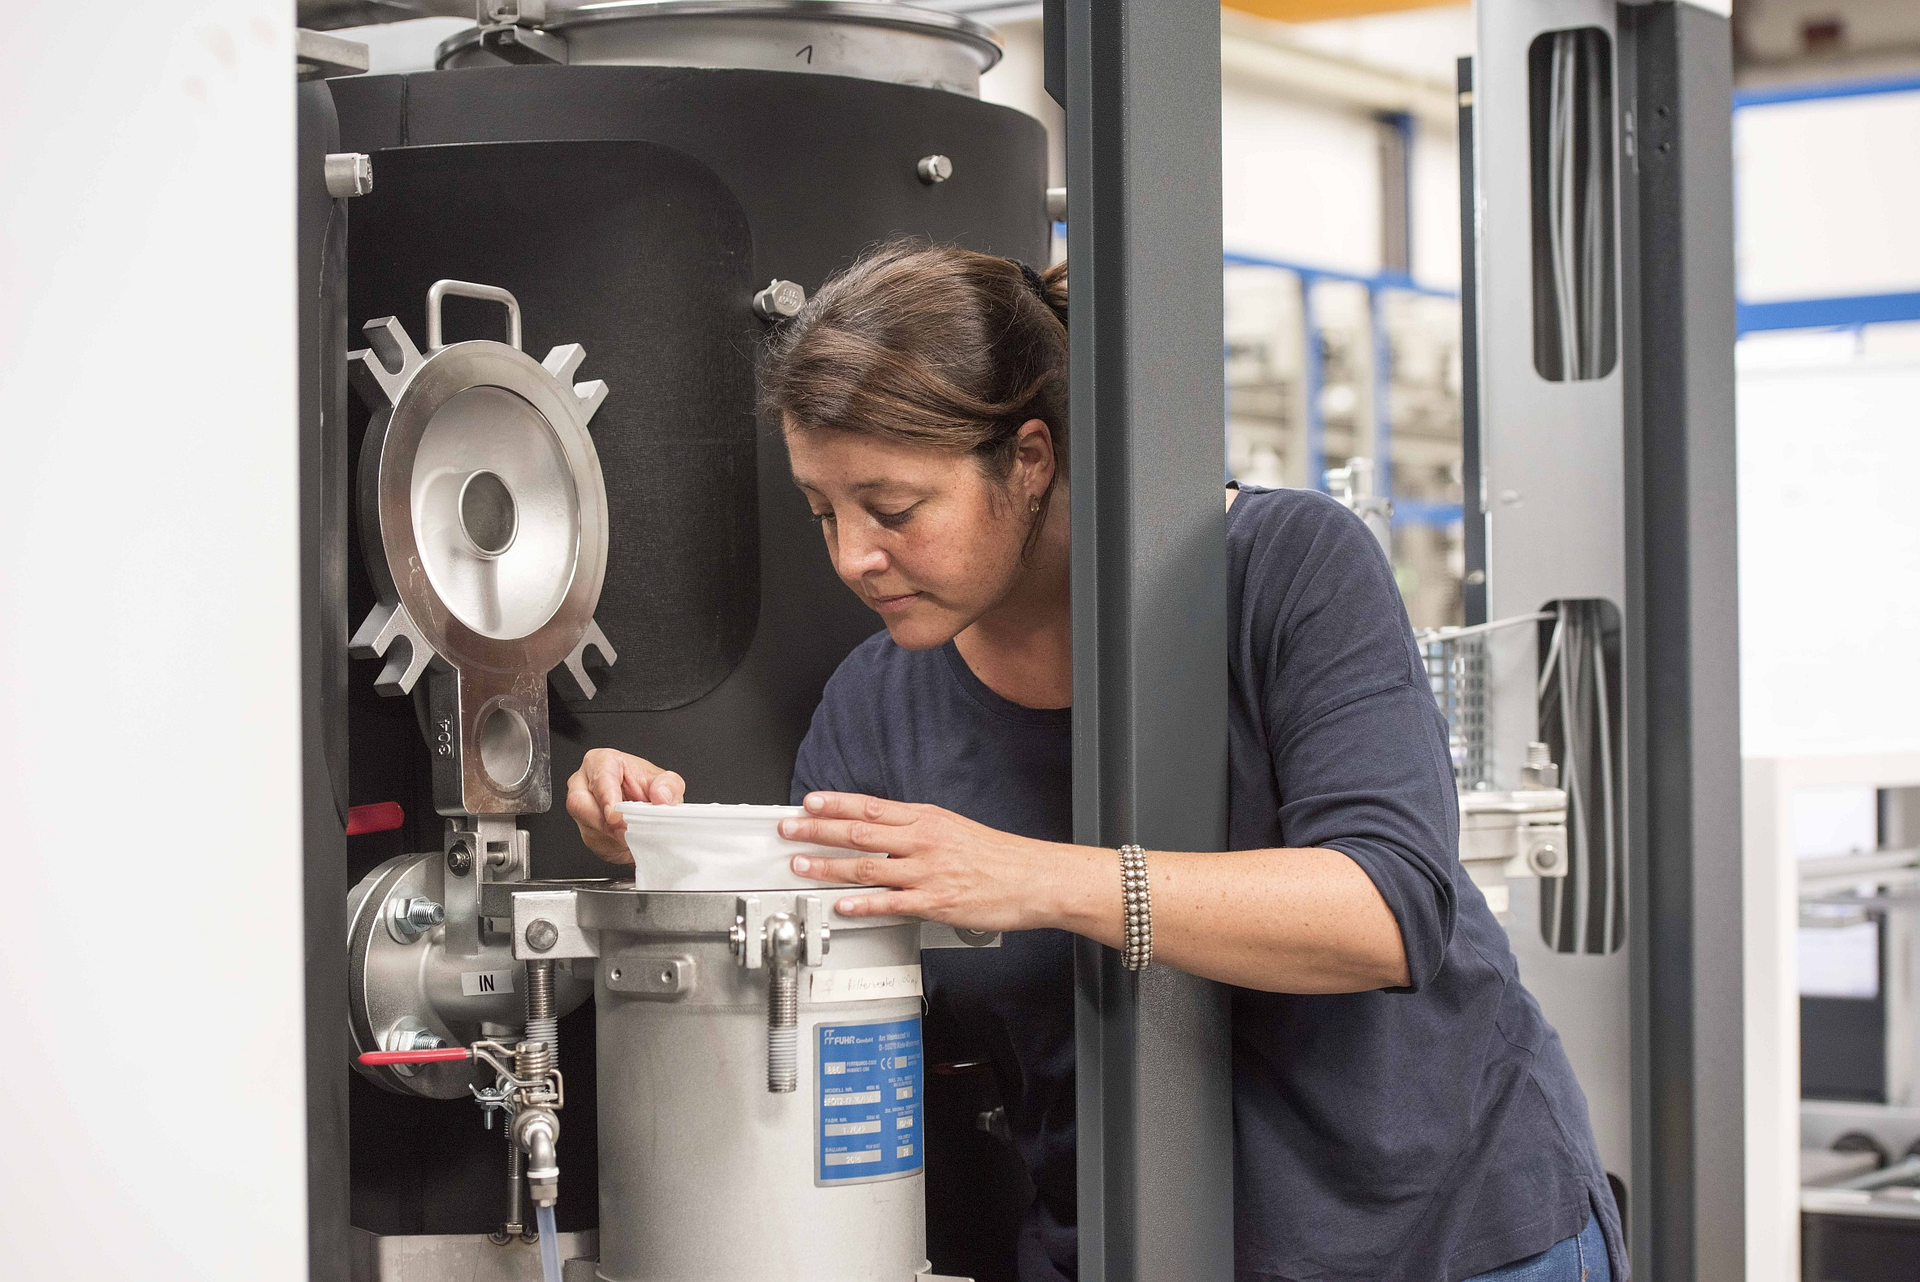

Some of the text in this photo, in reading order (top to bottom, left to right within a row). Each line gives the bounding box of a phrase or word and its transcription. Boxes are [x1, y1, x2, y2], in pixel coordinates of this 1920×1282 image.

[795, 45, 813, 64] 1
[437, 718, 451, 755] 304
[479, 974, 495, 992] IN
[834, 1035, 856, 1045] FUHR
